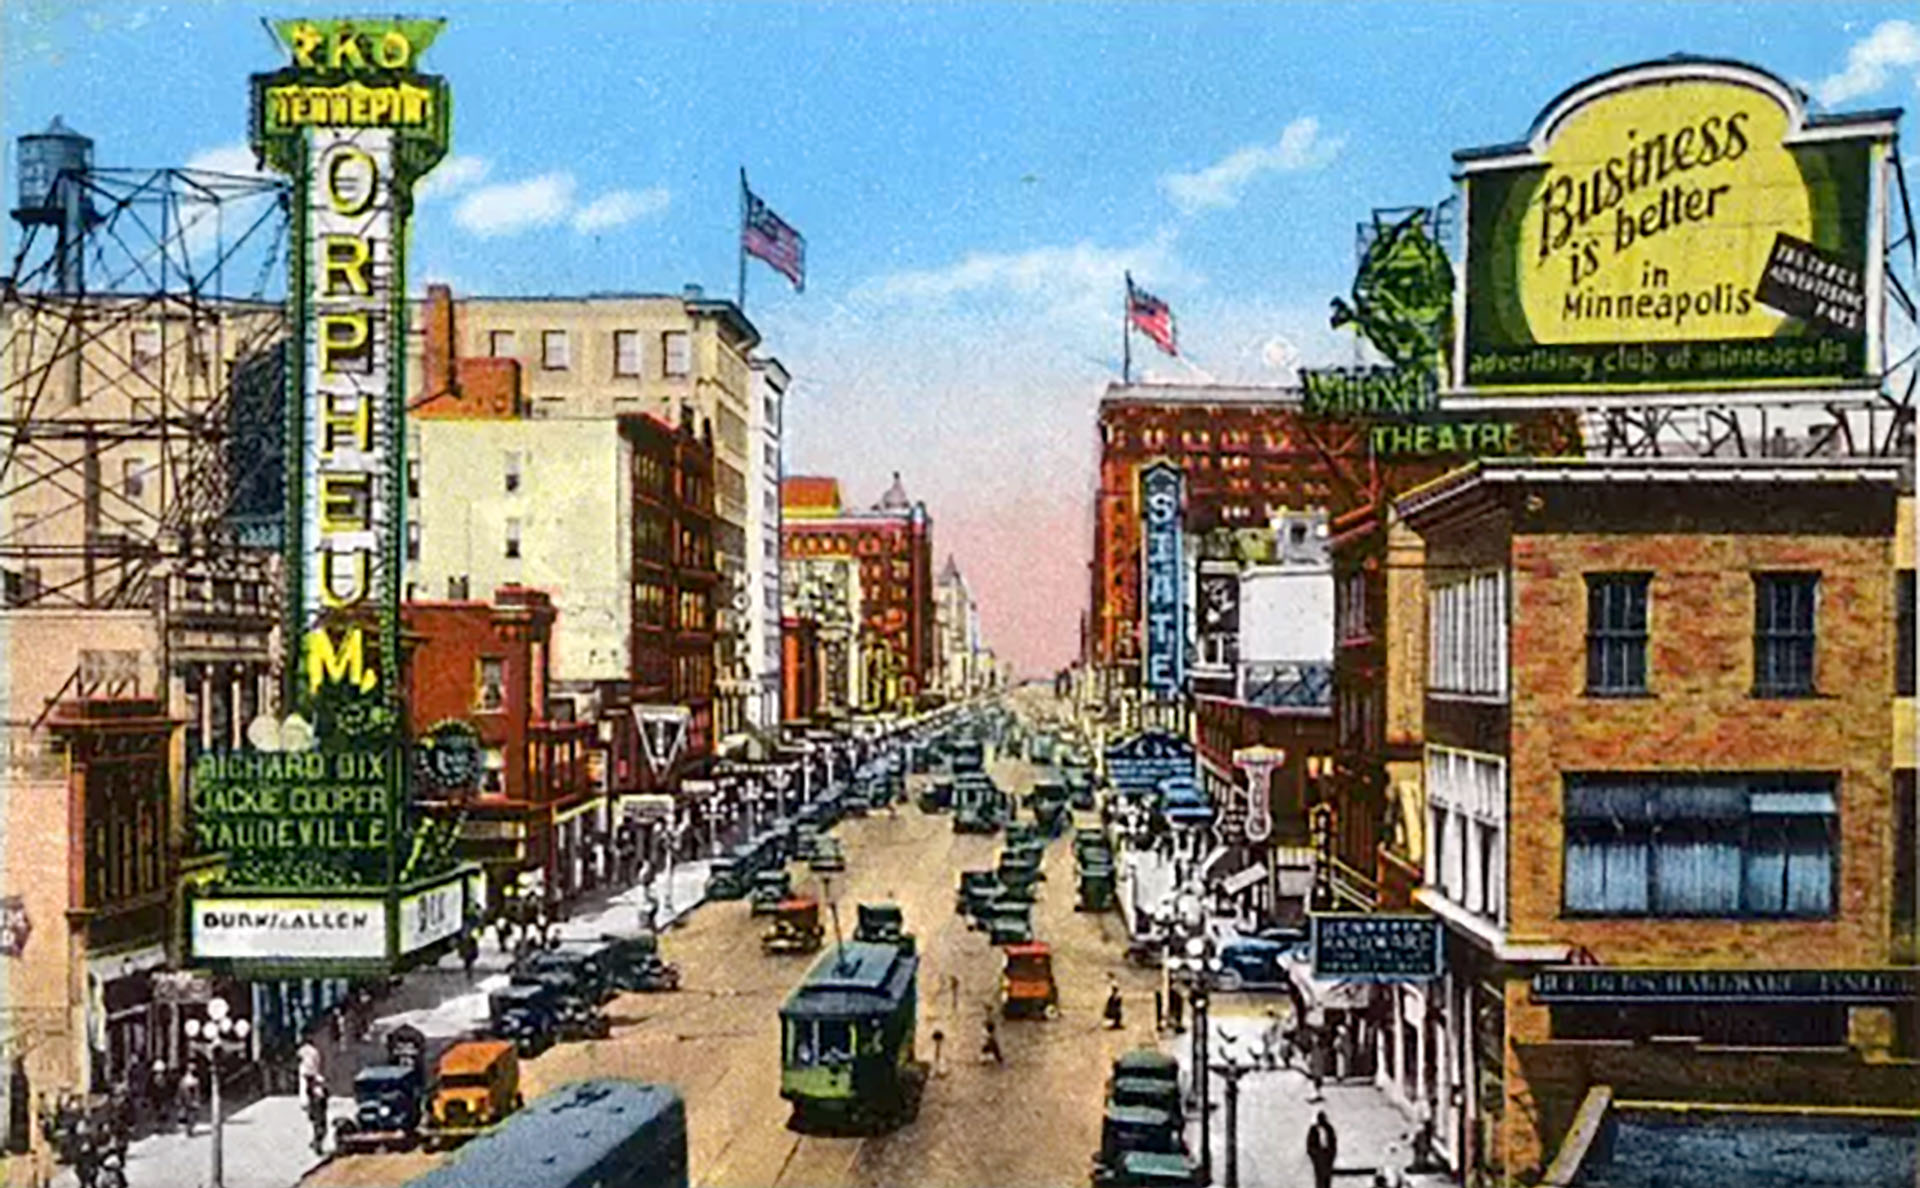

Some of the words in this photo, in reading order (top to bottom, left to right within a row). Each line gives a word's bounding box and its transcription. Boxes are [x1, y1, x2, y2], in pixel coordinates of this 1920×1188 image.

[290, 24, 410, 68] RKO
[1538, 111, 1749, 268] Business
[1570, 237, 1599, 287] is
[1614, 184, 1731, 254] better
[1642, 260, 1669, 287] in
[1561, 285, 1752, 326] Minneapolis
[1602, 344, 1658, 372] club
[303, 148, 378, 694] ORPHEUM
[1372, 423, 1523, 451] THEATRE
[1149, 493, 1177, 687] STATE
[198, 753, 324, 779] RICHARD
[337, 752, 385, 779] DIX
[194, 787, 283, 814] JACKIE
[289, 786, 387, 814] COOPER
[195, 818, 388, 848] VAUDEVILLE
